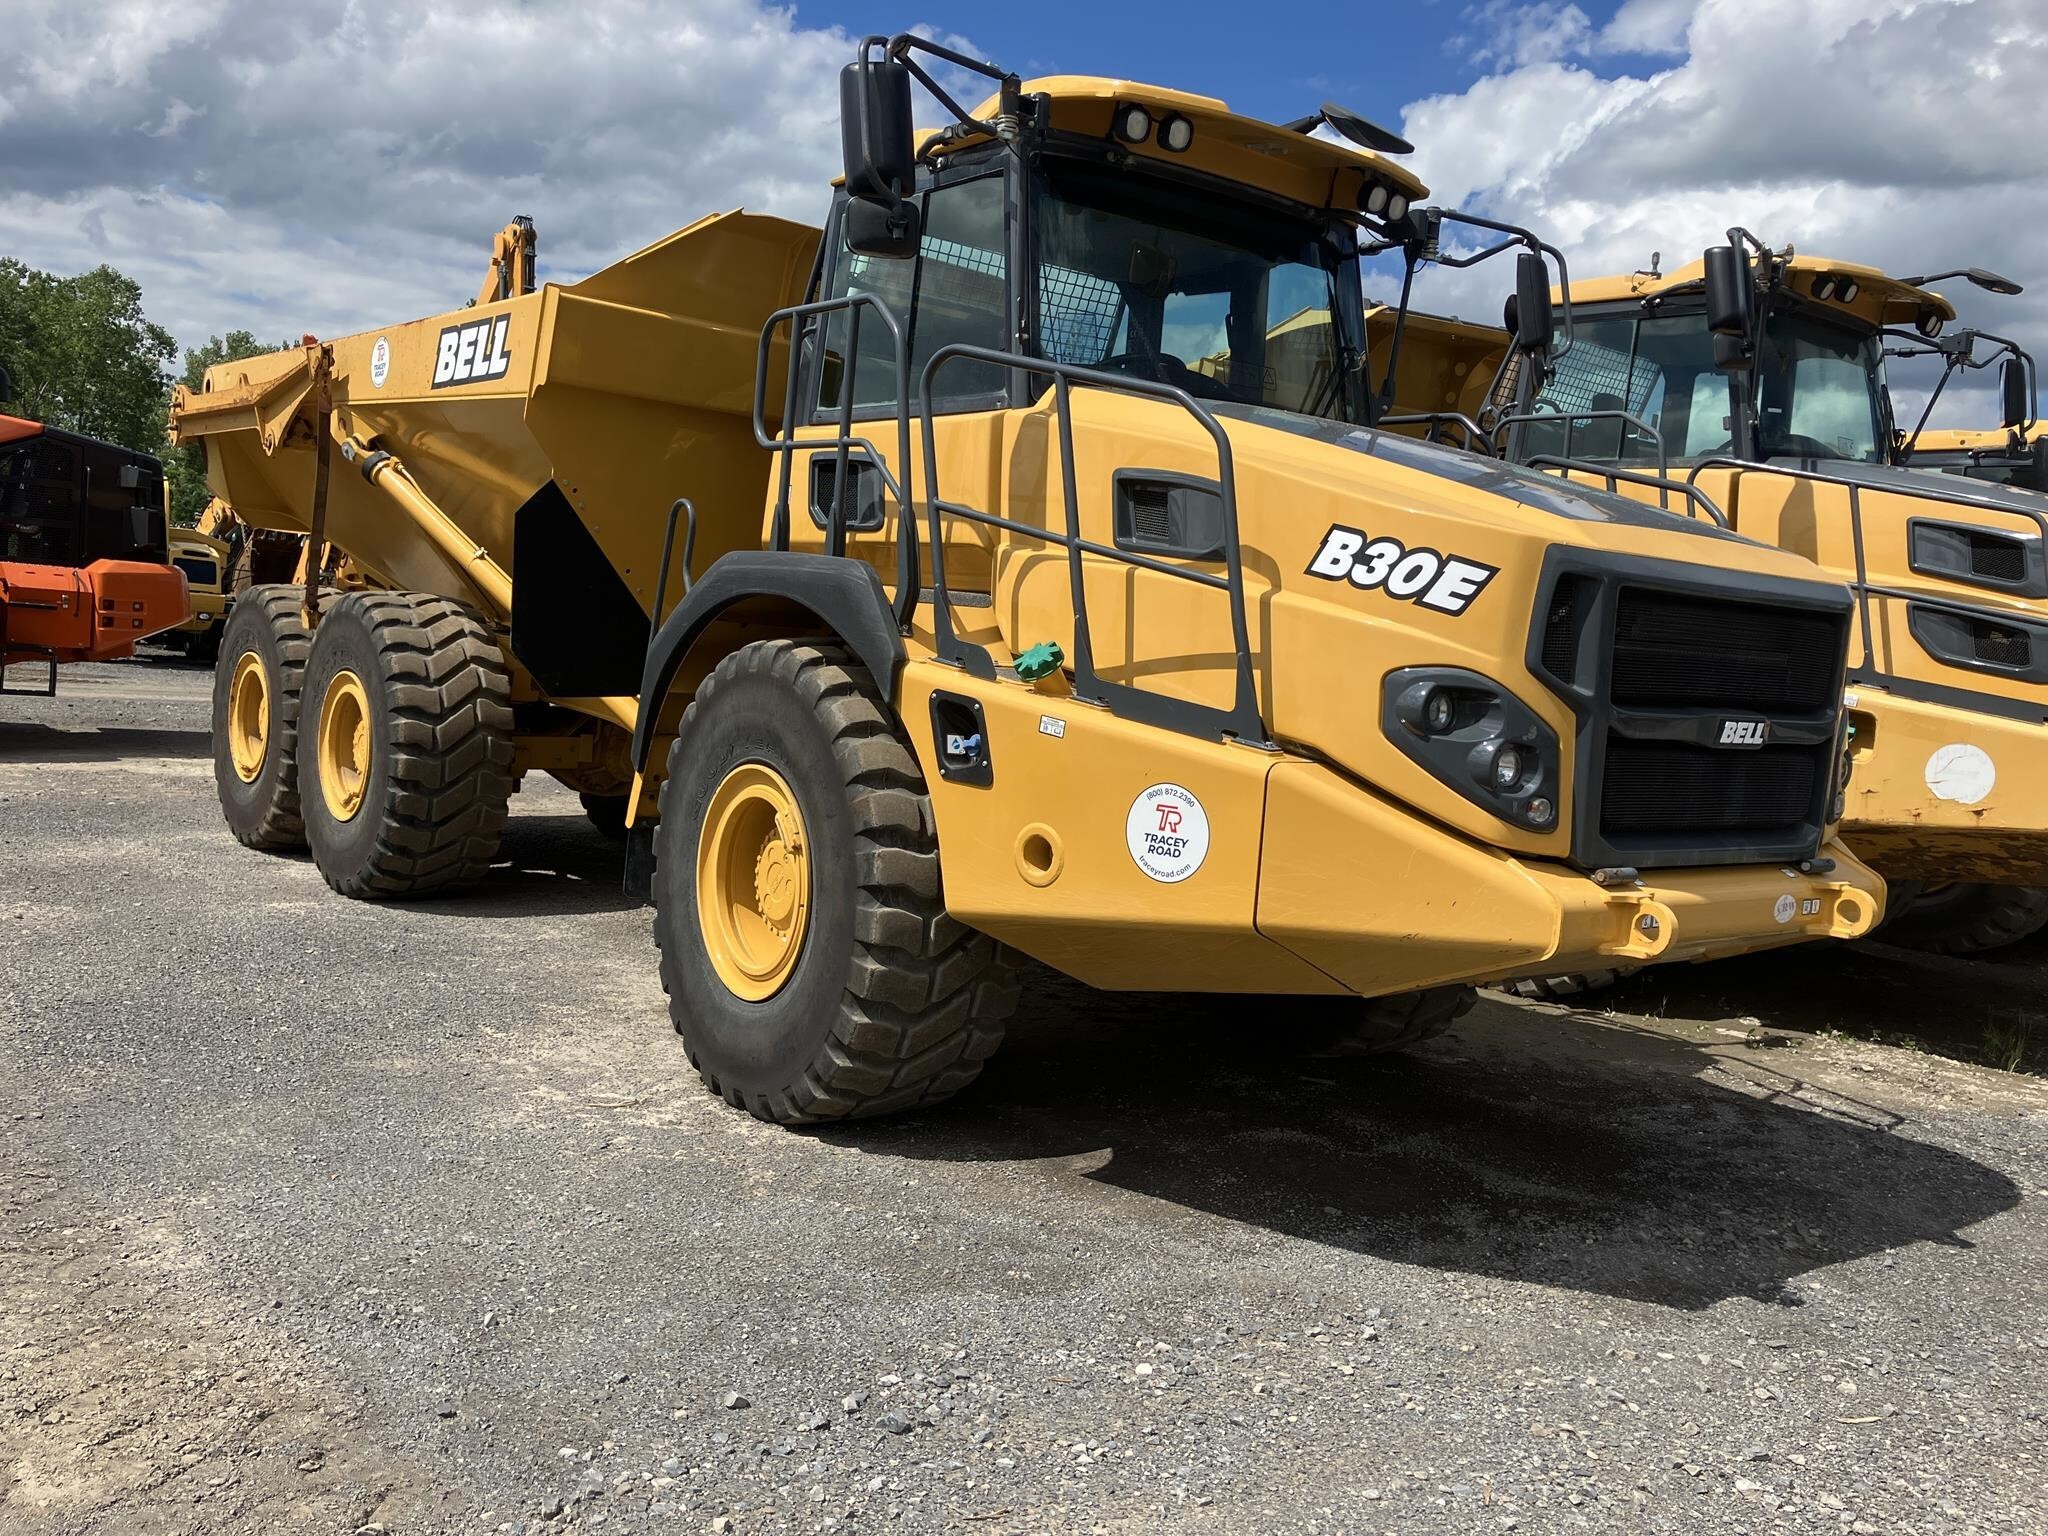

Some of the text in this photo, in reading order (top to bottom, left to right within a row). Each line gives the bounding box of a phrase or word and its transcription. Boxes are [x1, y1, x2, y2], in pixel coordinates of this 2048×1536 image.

[433, 319, 509, 385] BELL
[1308, 527, 1493, 613] B30E
[1719, 721, 1765, 745] BELL
[1147, 787, 1195, 808] (800) 872.2390
[1144, 832, 1189, 849] TRACEY
[1147, 844, 1181, 858] ROAD
[1139, 855, 1192, 878] traceyroad.com
